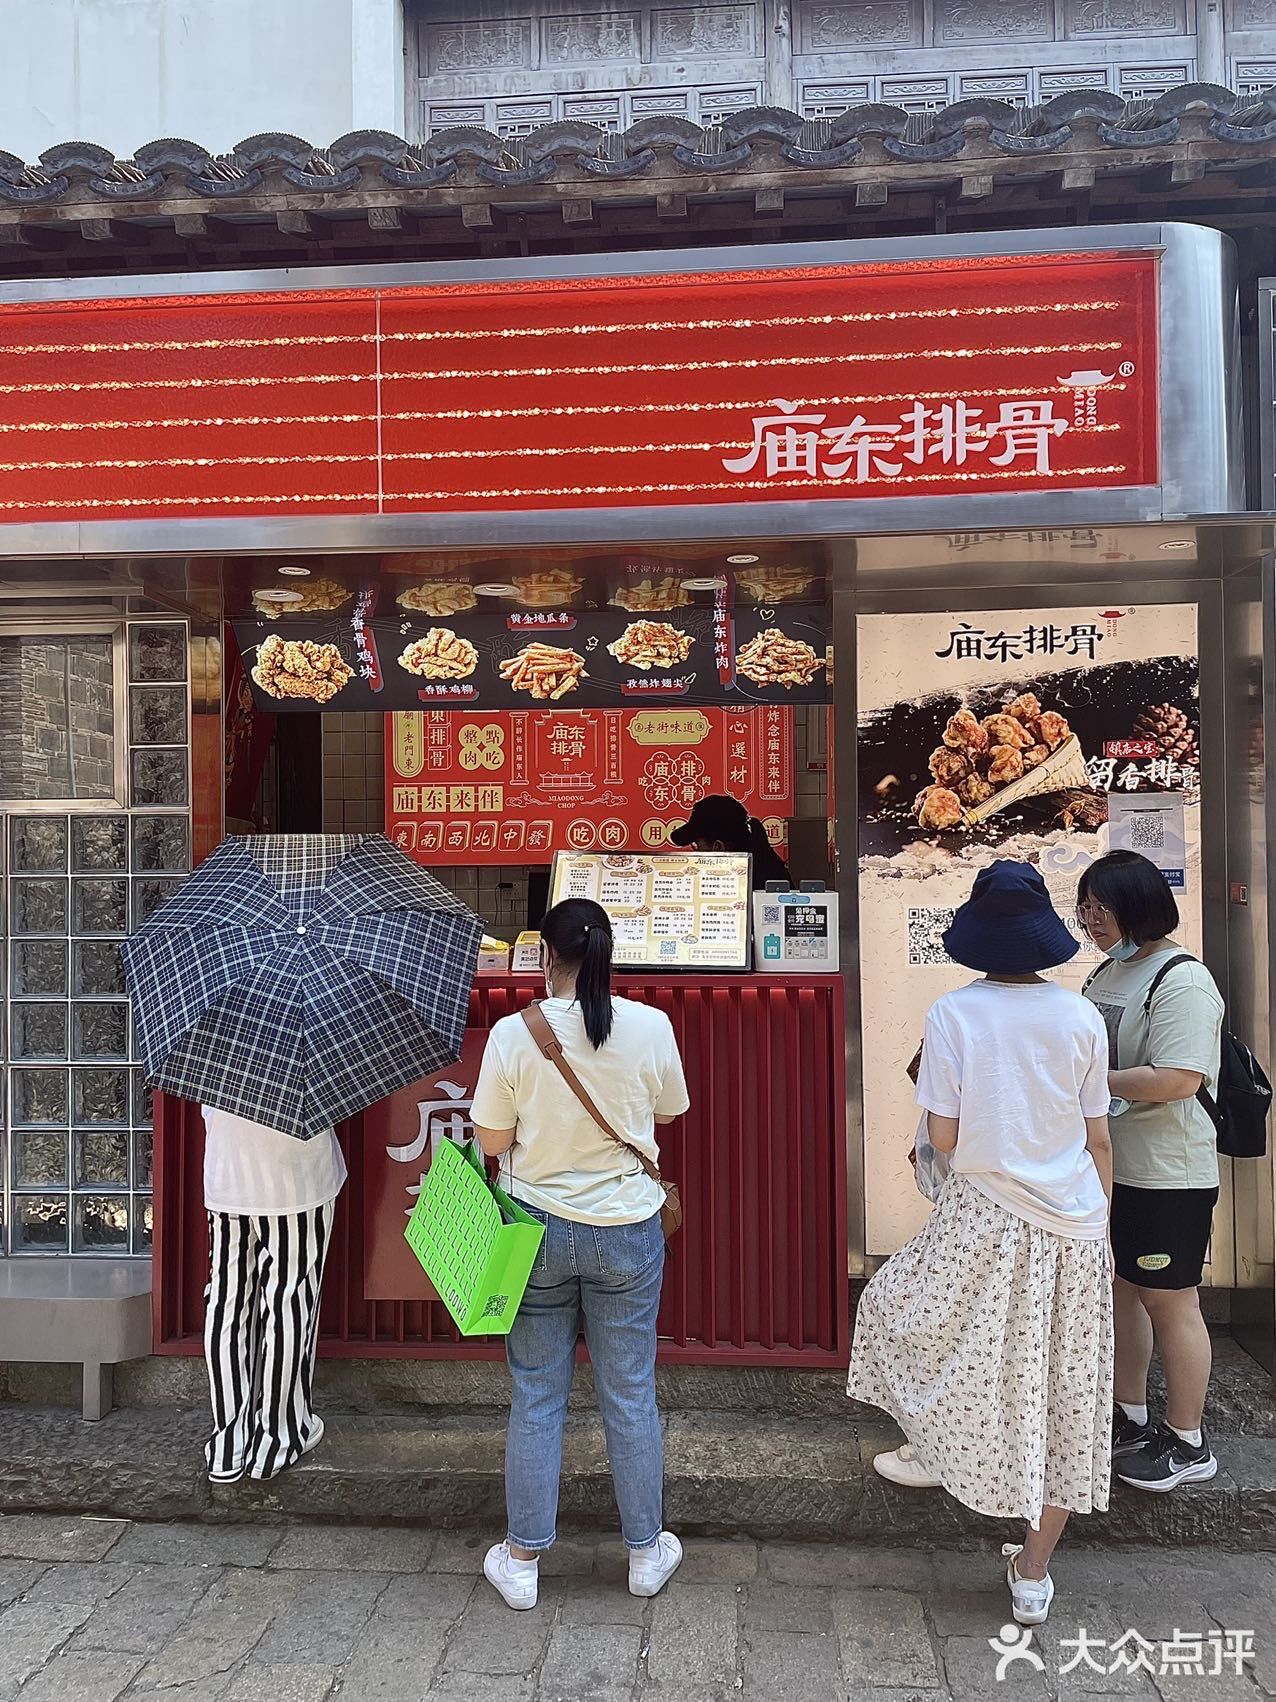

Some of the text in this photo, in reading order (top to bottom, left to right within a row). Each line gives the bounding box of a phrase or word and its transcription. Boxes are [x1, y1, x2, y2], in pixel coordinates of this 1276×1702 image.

[1074, 387, 1085, 427] MIAO
[721, 398, 1069, 483] 庙东排骨
[511, 612, 569, 625] 黄金地瓜条
[350, 617, 376, 680] 香骨鸡块
[711, 610, 729, 669] 庙东炸肉
[935, 622, 1104, 663] 庙东排骨
[424, 683, 474, 696] 香酥鸡柳
[626, 678, 686, 689] 孜然炸翅尖
[644, 720, 695, 734] 老街味道
[767, 705, 780, 792] 炸念庙东来伴
[1084, 755, 1199, 793] 留香排骨
[396, 789, 499, 811] 庙东来伴
